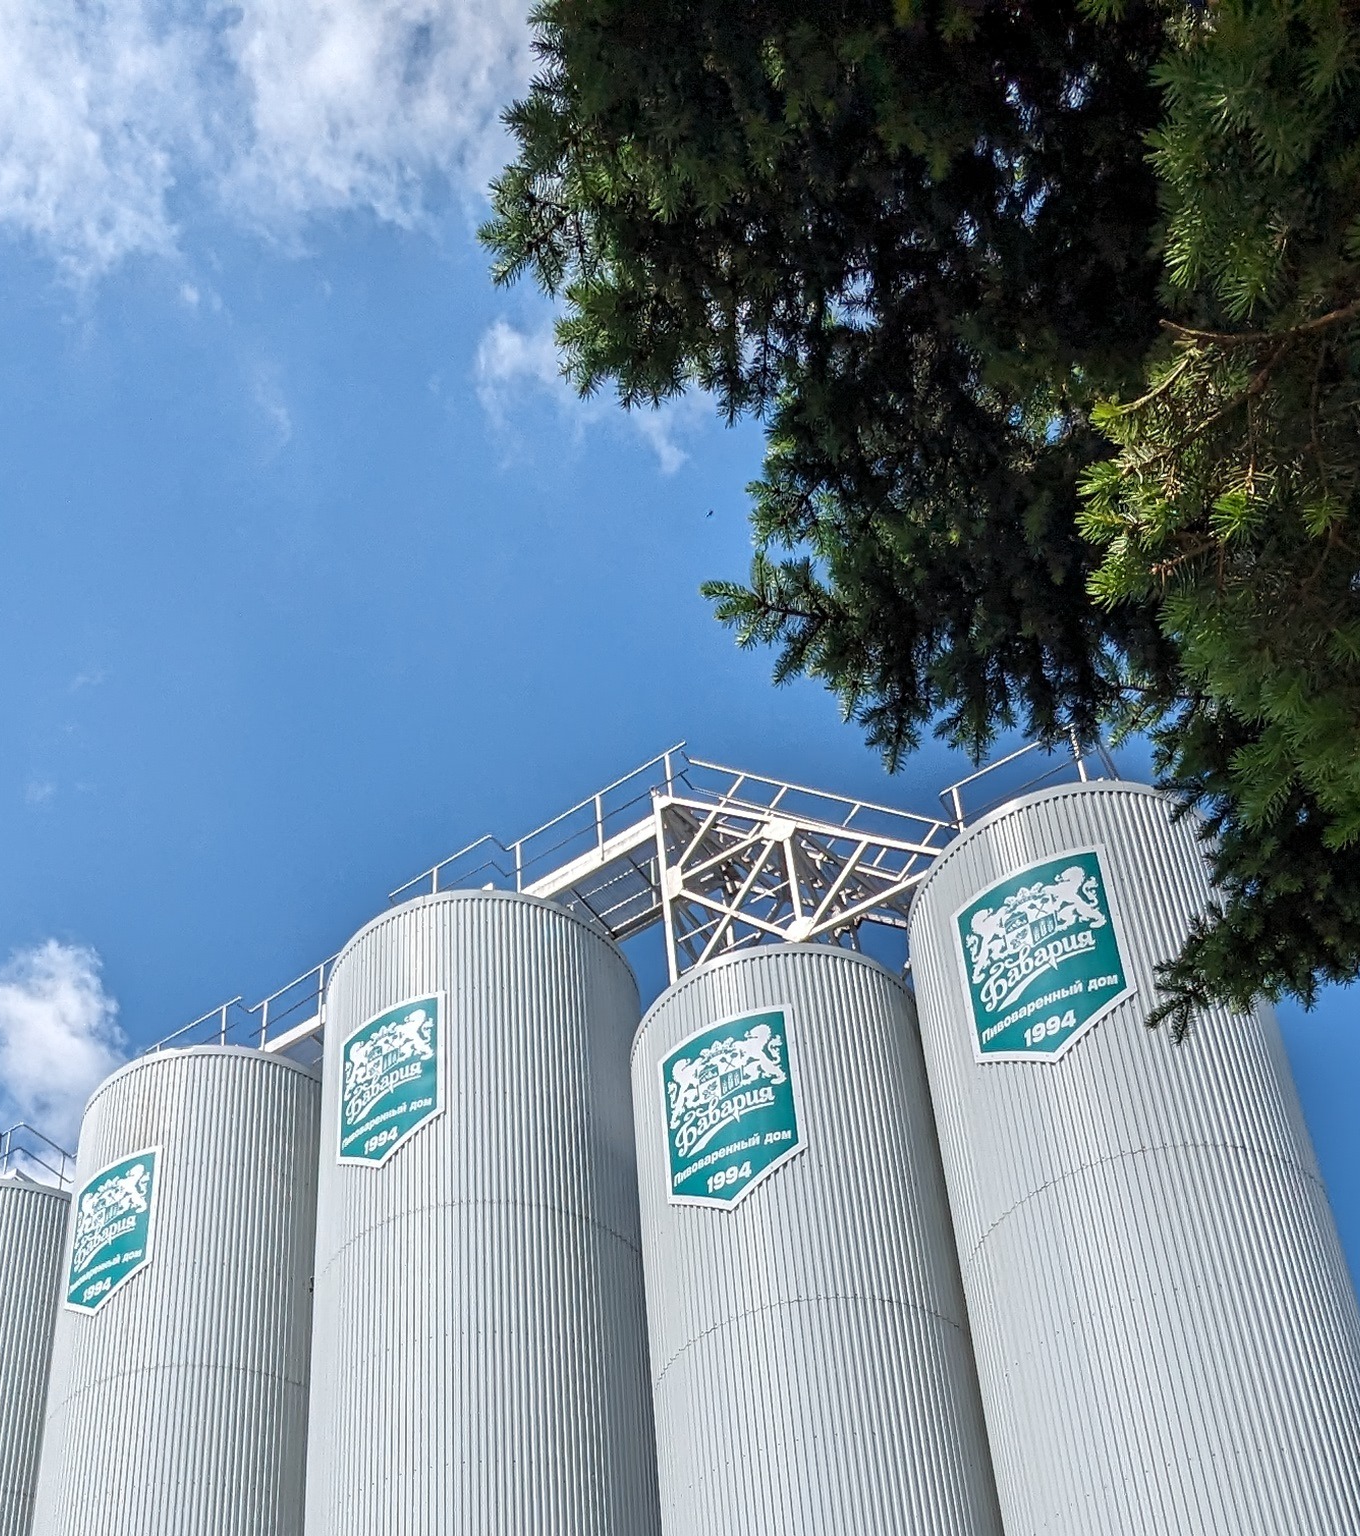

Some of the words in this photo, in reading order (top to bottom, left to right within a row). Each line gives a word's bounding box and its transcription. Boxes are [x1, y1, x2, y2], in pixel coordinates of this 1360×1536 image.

[980, 930, 1096, 1012] Бавария
[982, 980, 1083, 1044] Пивоваренный
[1088, 974, 1118, 991] дом
[1023, 1009, 1077, 1047] 1994
[346, 1061, 422, 1125] Бавария
[675, 1085, 775, 1157] Бавария
[364, 1126, 398, 1155] 1994
[674, 1133, 760, 1187] Пивоваренный
[763, 1130, 792, 1145] дом
[707, 1161, 752, 1194] 1994
[82, 1277, 112, 1303] 1994
